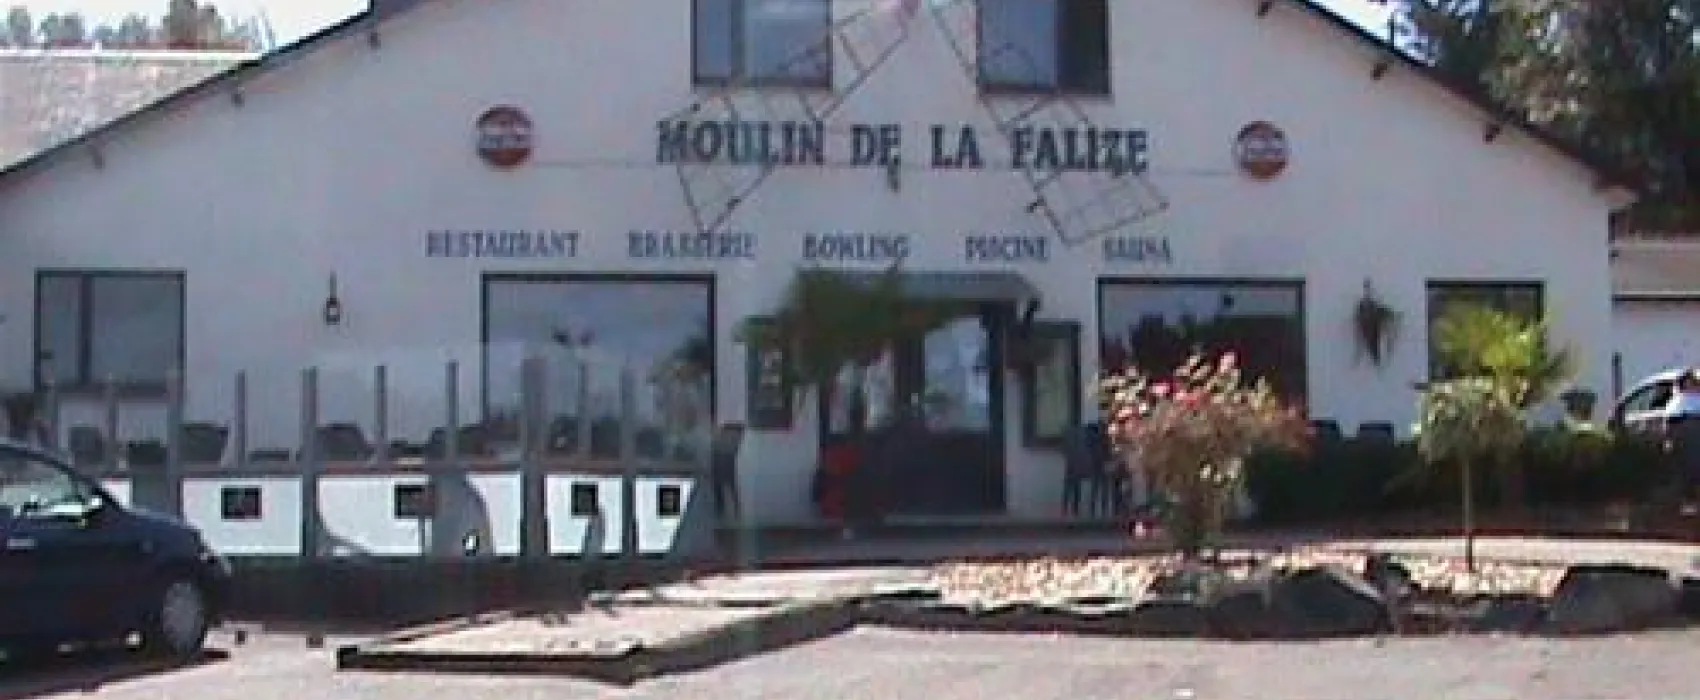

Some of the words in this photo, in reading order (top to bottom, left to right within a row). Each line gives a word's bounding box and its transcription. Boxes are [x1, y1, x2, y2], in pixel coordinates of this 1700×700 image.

[656, 120, 825, 165] MOULIN
[850, 123, 901, 168] DE
[931, 124, 984, 169] LA
[1011, 127, 1148, 174] FALIZE
[425, 230, 580, 259] RESTAURANT
[803, 232, 910, 261] BOWLING
